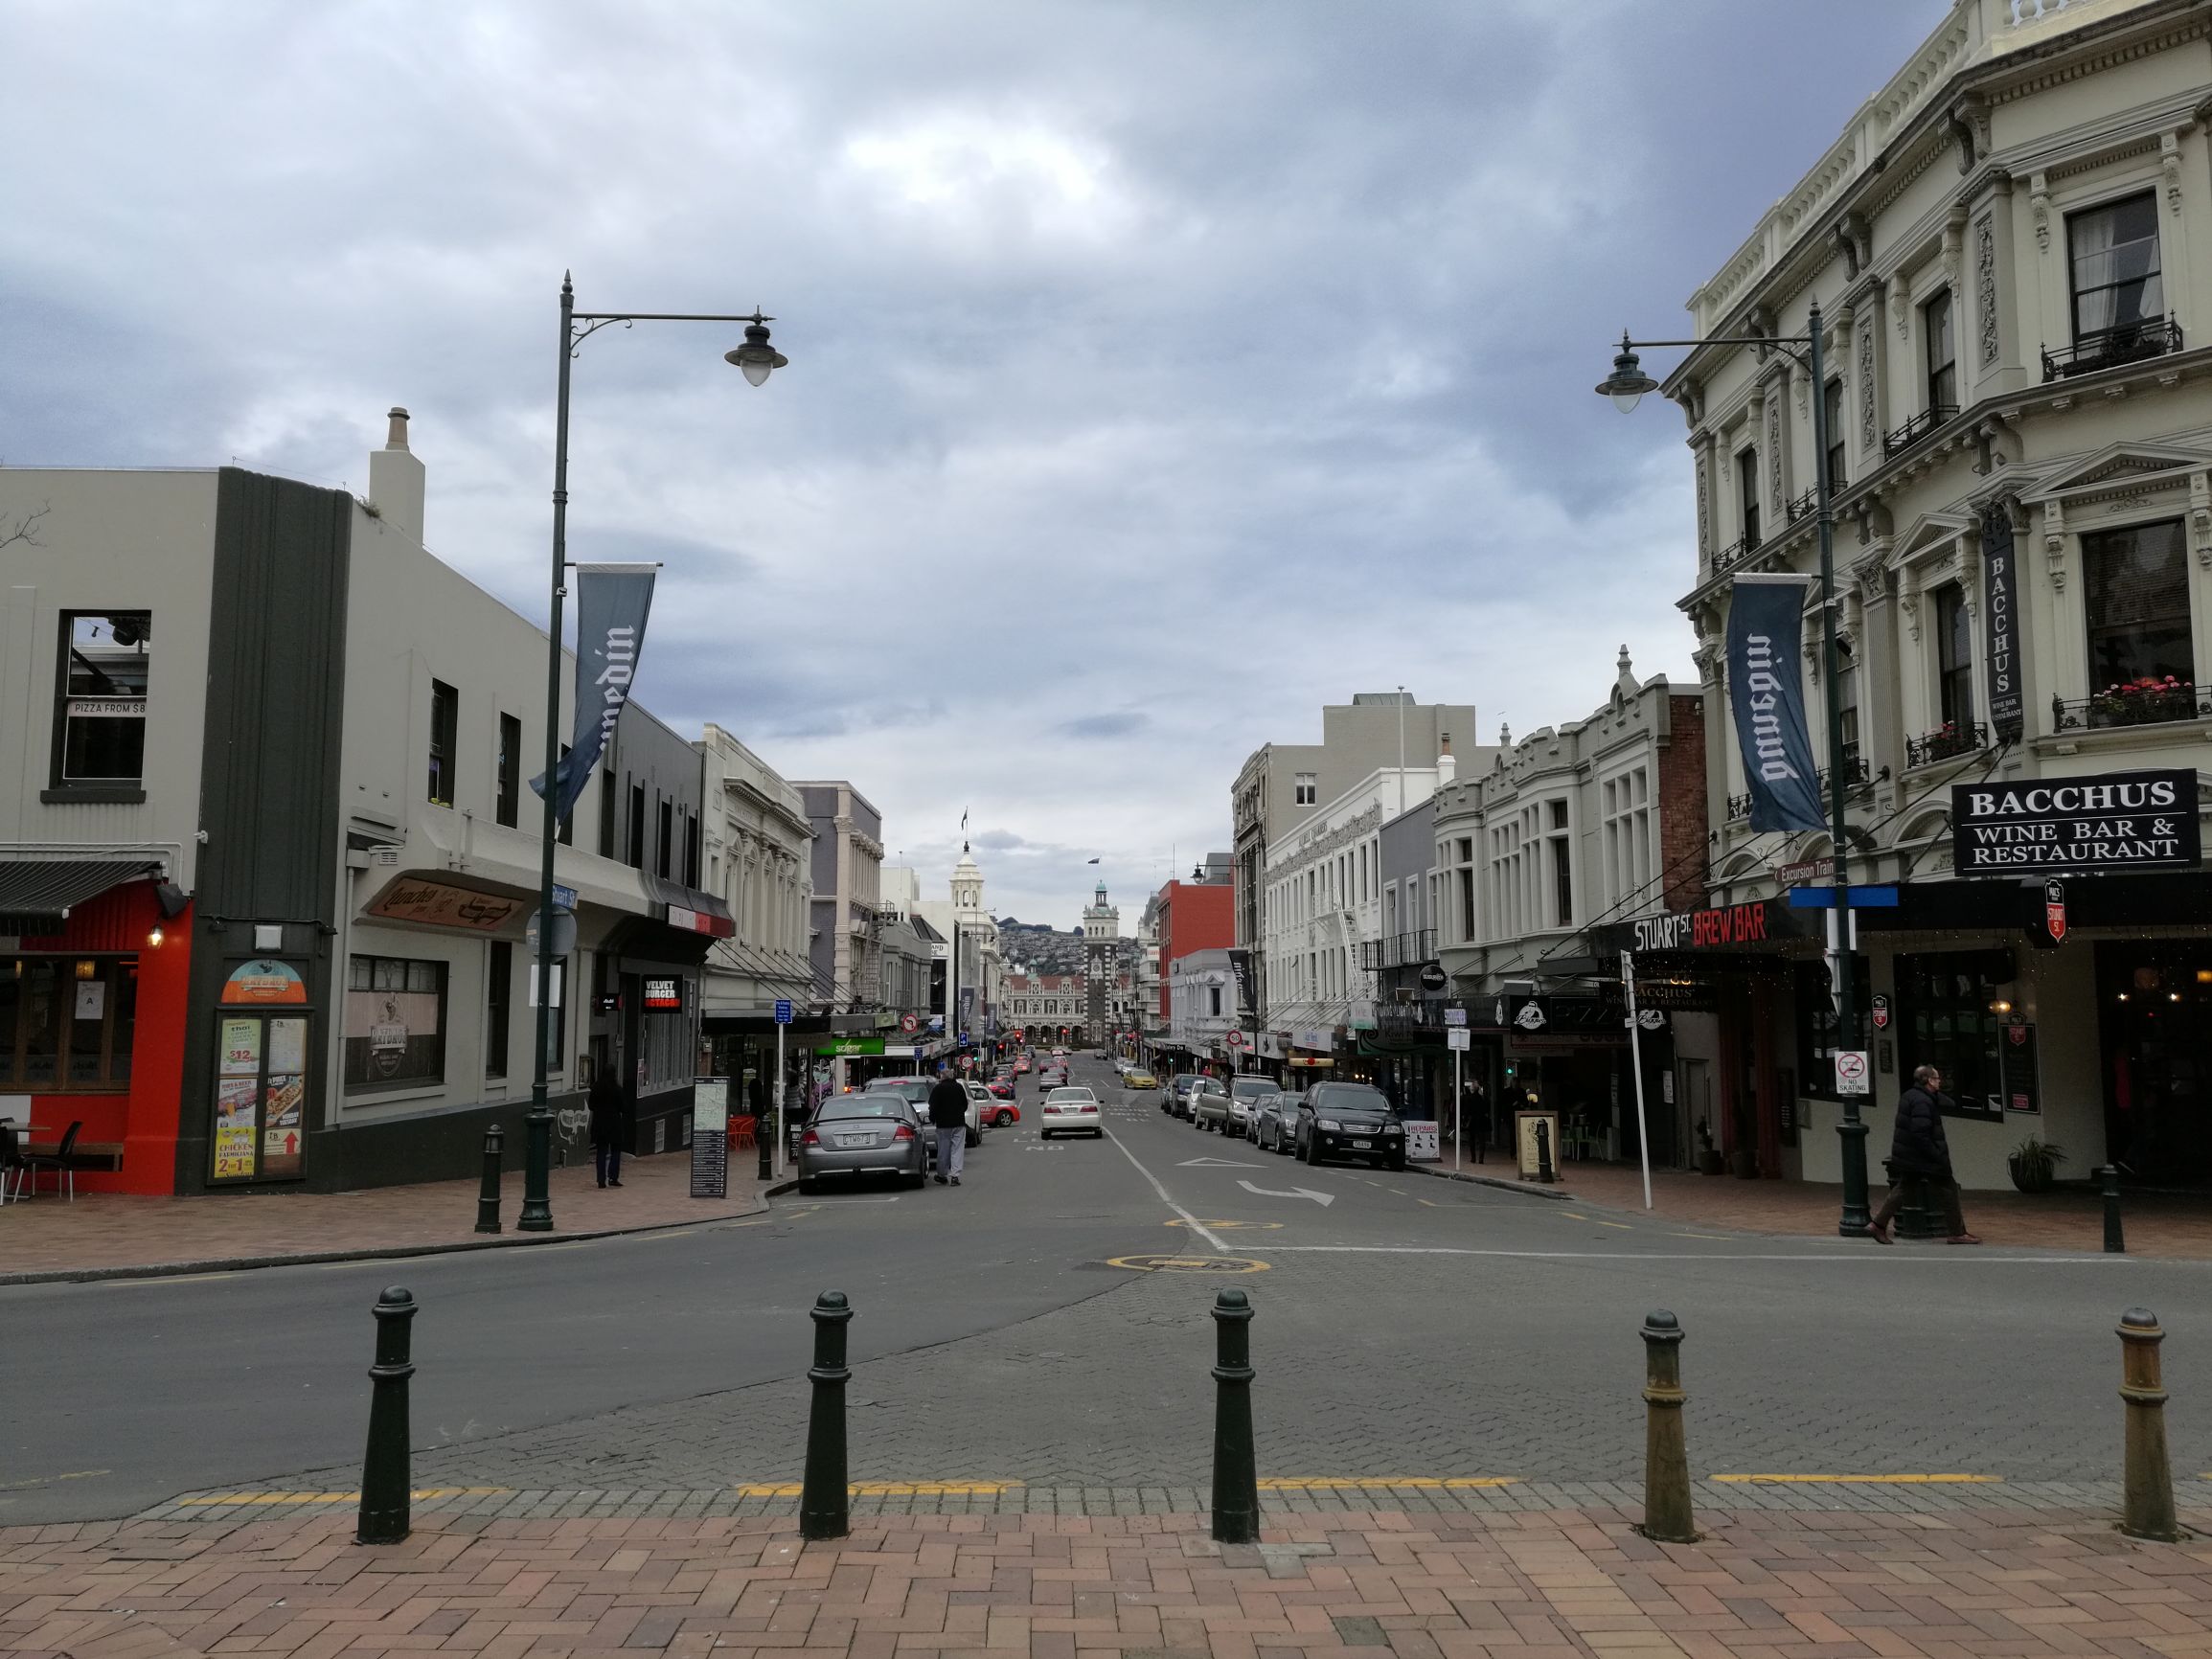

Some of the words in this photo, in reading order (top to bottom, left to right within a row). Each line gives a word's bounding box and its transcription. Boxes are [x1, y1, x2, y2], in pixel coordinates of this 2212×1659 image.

[1992, 557, 2010, 693] BACCHUS
[75, 703, 103, 713] PIZZA
[104, 704, 130, 713] FROM
[1969, 781, 2176, 816] BACCHUS
[1973, 824, 2058, 844] WINE
[2073, 820, 2138, 839] BAR
[2152, 818, 2176, 836] &
[1973, 838, 2179, 864] RESTAURANT
[1782, 864, 1814, 882] Excursion
[1815, 859, 1834, 875] Train
[1634, 915, 1679, 951] STUART
[1680, 914, 1692, 933] ST.
[1693, 908, 1732, 946] BREW
[1734, 902, 1766, 942] BAR
[645, 989, 675, 998] BURGER
[646, 980, 674, 989] VELVET
[230, 1050, 250, 1059] $12
[218, 1159, 228, 1172] 2
[236, 1158, 243, 1170] 1
